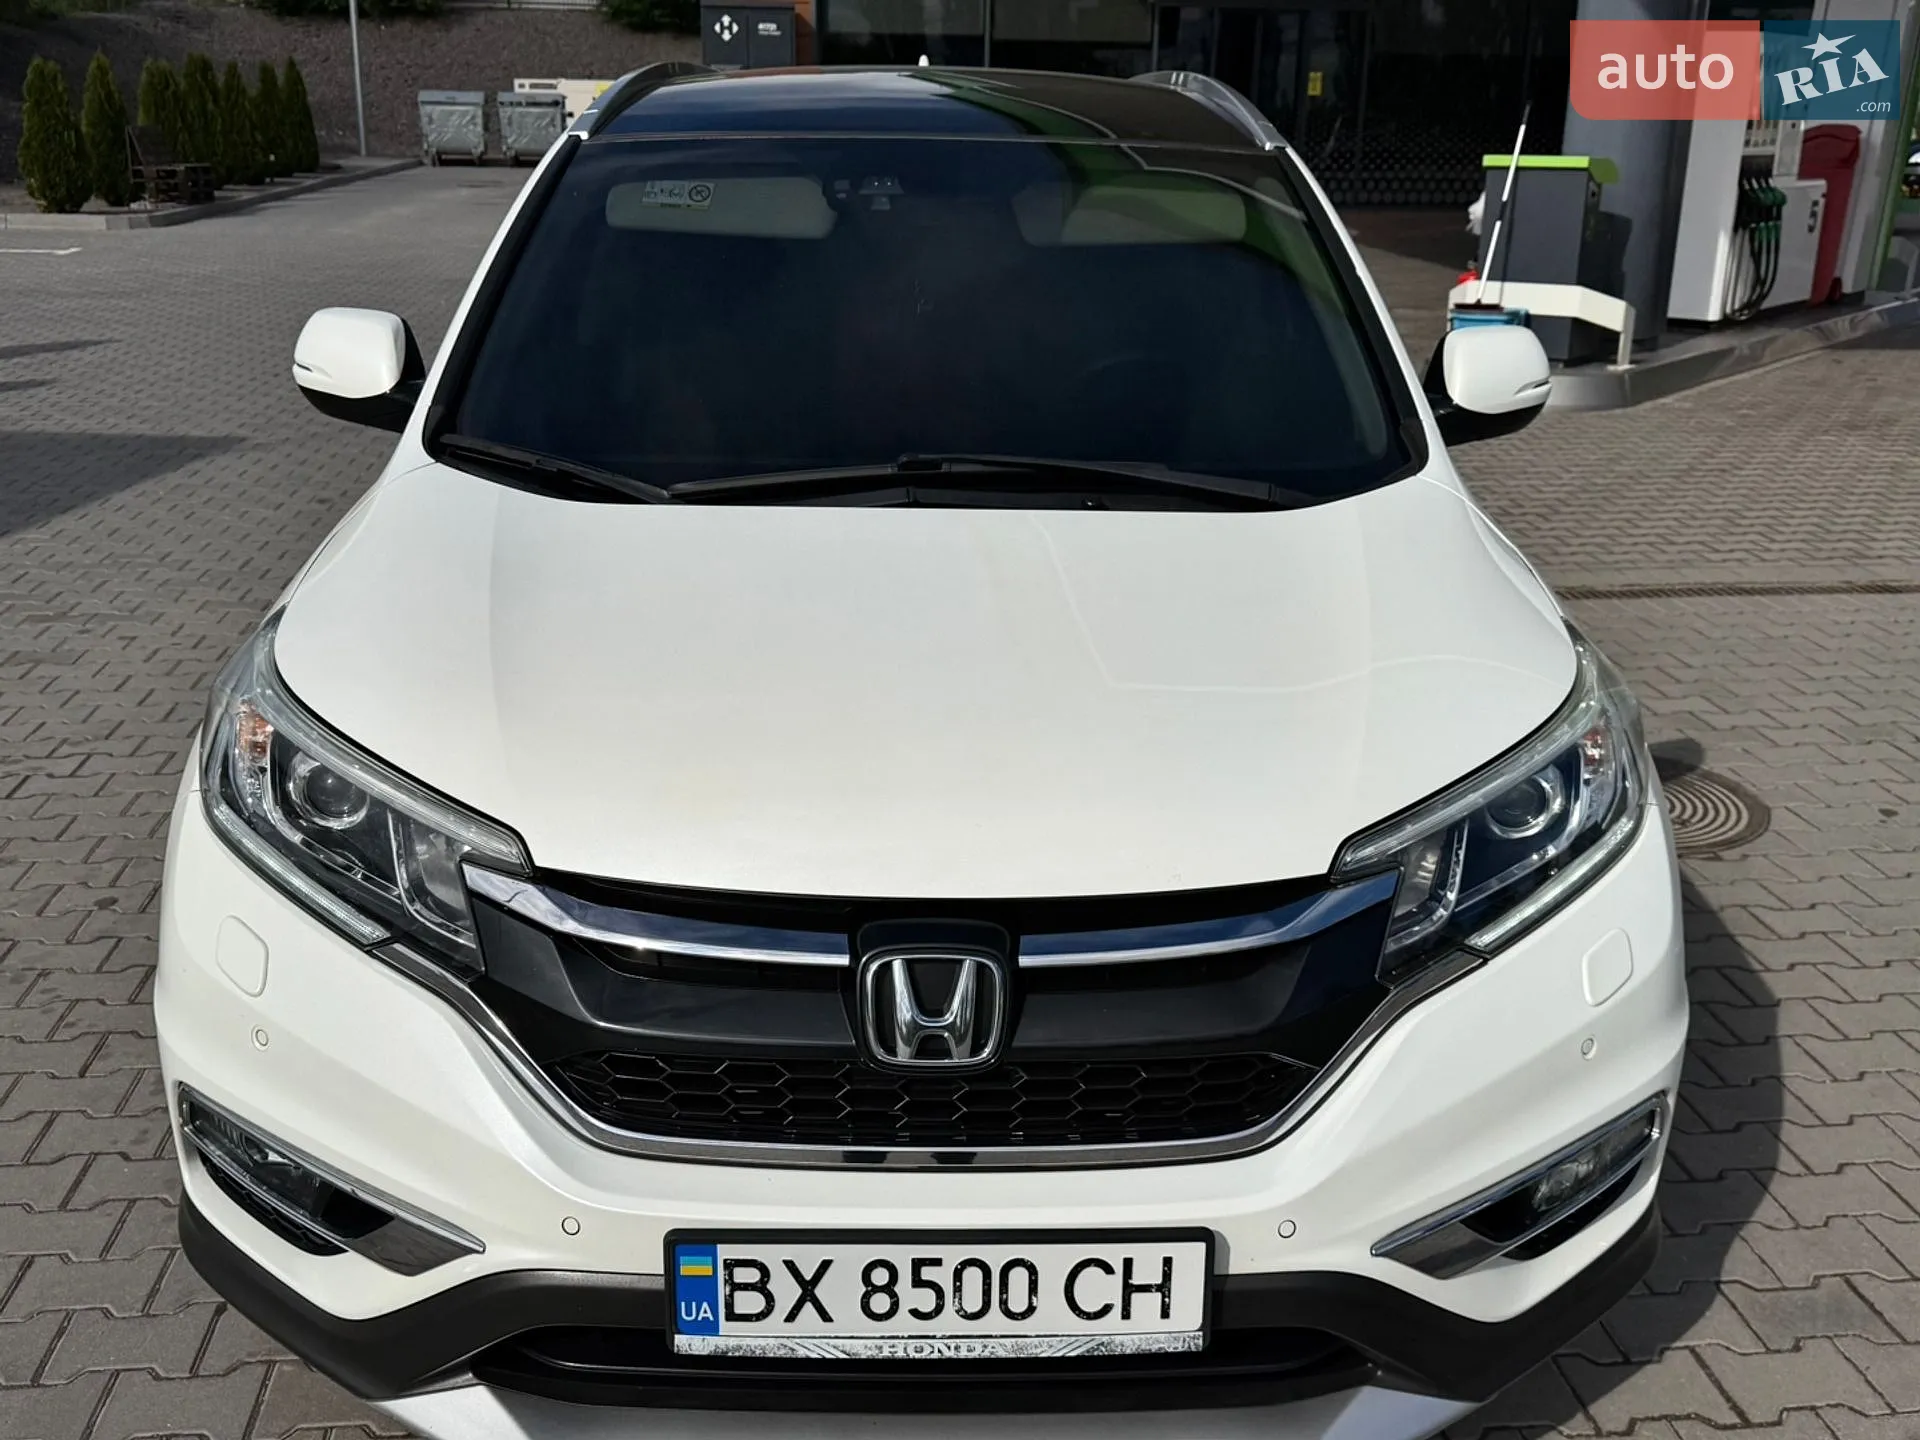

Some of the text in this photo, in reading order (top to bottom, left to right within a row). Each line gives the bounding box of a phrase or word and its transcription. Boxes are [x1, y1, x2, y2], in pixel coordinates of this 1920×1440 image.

[1807, 199, 1820, 234] 5
[722, 1255, 1173, 1323] BX 8500 CH
[681, 1302, 714, 1322] UA
[879, 1341, 1009, 1357] HONDA
